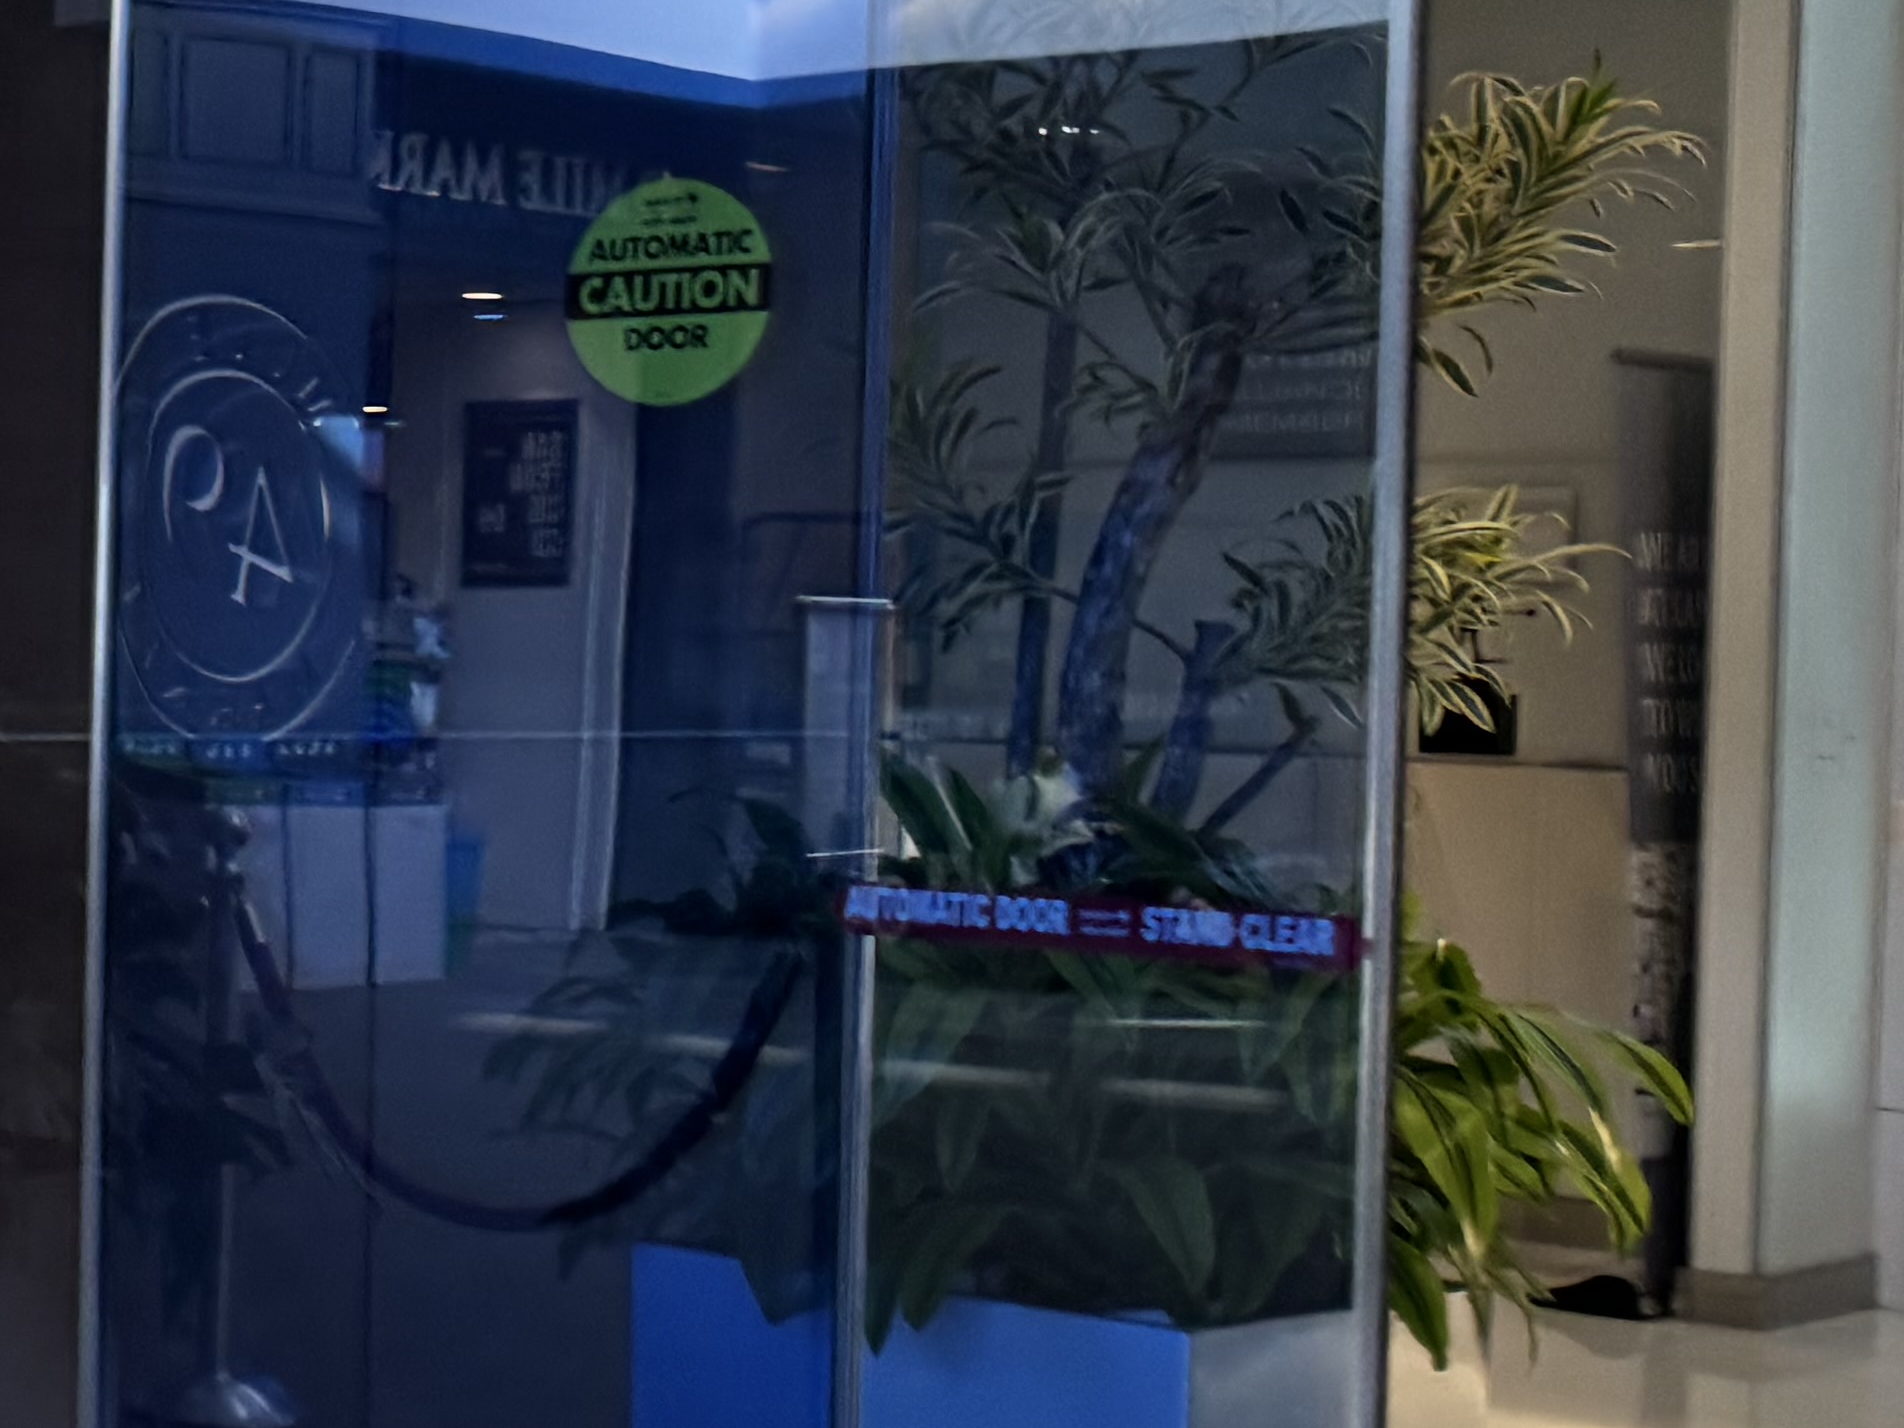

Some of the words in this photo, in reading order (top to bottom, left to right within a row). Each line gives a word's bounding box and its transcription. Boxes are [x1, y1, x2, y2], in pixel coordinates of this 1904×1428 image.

[588, 228, 754, 262] AUTOMATIC
[578, 268, 759, 315] CAUTION
[623, 324, 710, 351] DOOR
